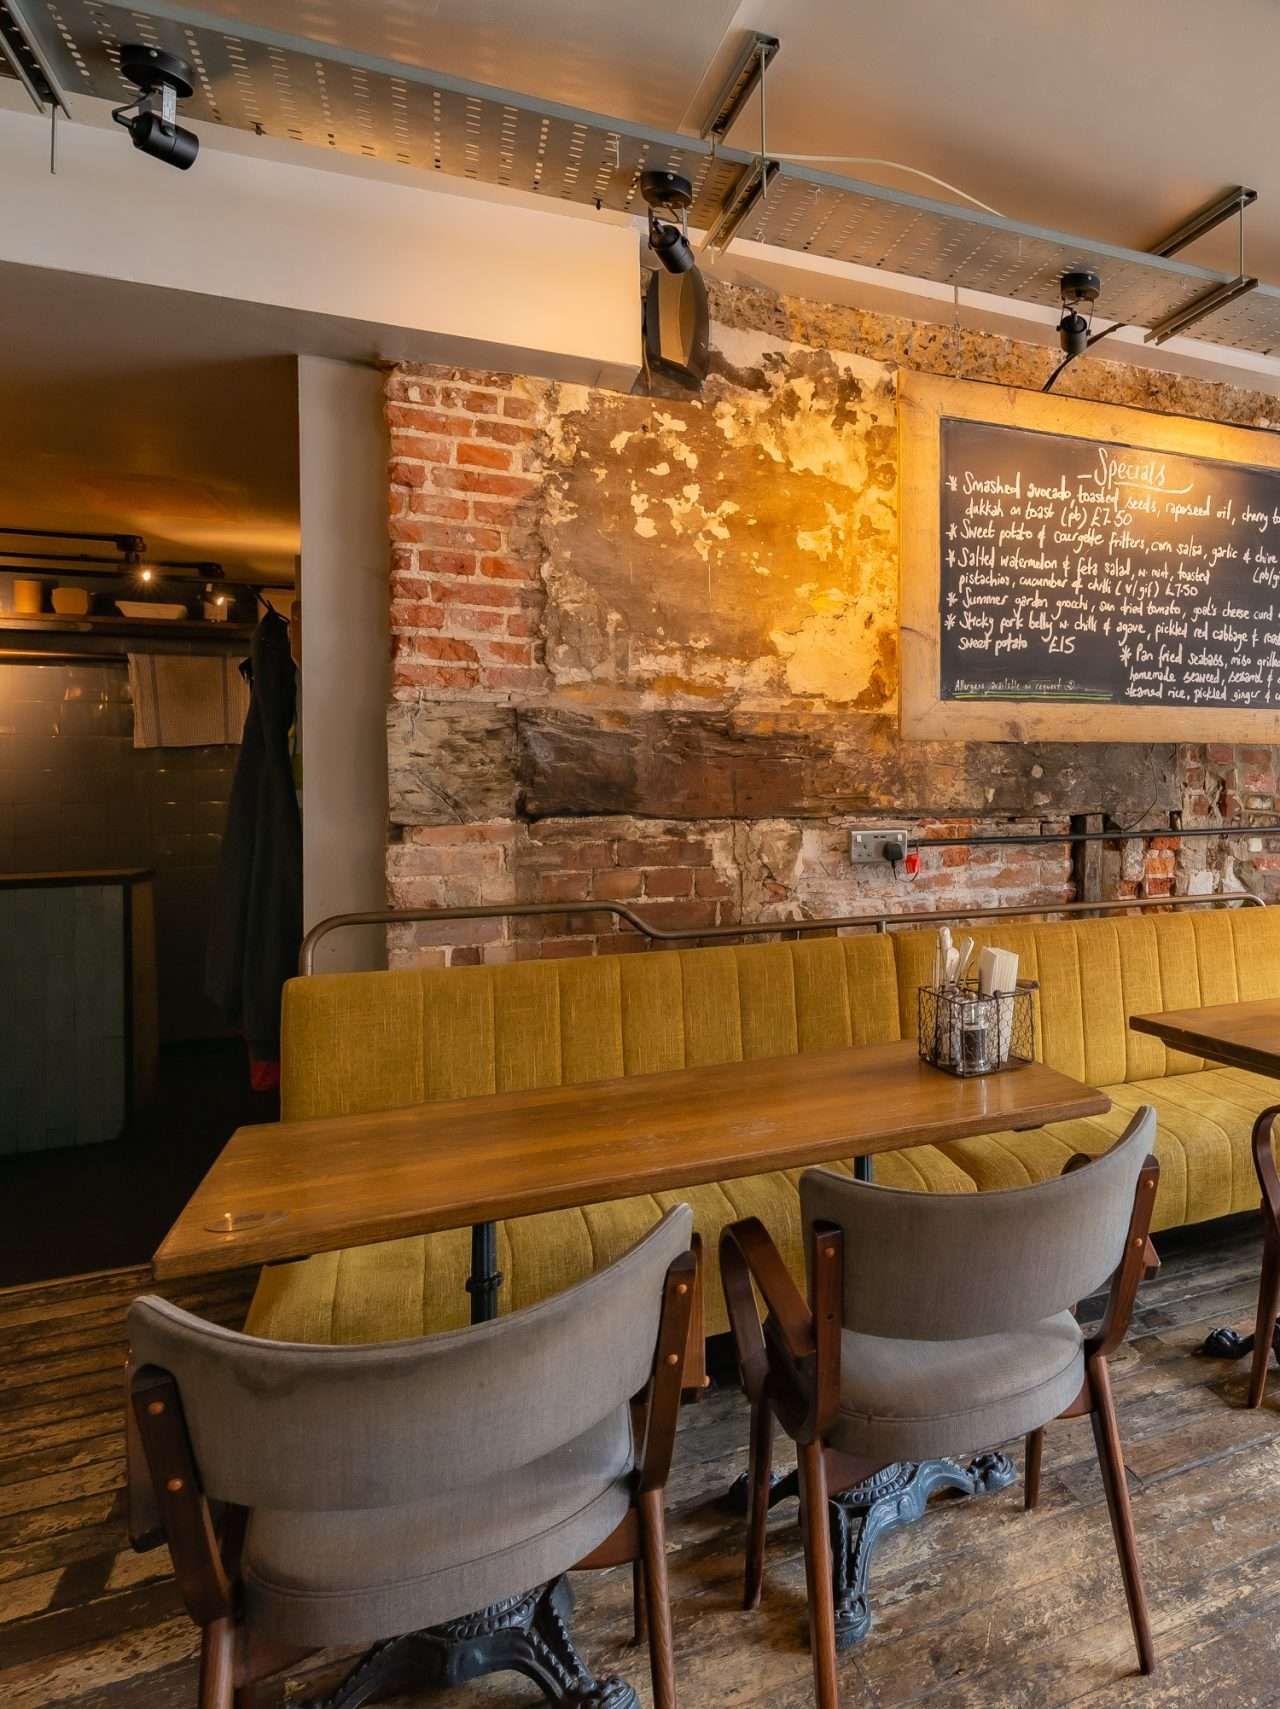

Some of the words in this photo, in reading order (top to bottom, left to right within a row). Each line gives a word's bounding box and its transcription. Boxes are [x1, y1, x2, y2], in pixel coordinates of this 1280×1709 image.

[1094, 448, 1166, 488] Specials
[963, 472, 1021, 499] Smashed
[1027, 475, 1075, 508] avocado,
[1078, 484, 1119, 512] toasted
[1125, 496, 1160, 519] seeds,
[1216, 499, 1236, 525] oil,
[1242, 504, 1268, 533] cherry
[965, 497, 1004, 518] dukkah
[1010, 506, 1021, 516] on
[1025, 501, 1055, 519] toast
[1061, 505, 1087, 530] (pb)
[960, 518, 996, 539] Sweet
[999, 521, 1033, 547] potato
[1037, 524, 1046, 549] &
[1054, 528, 1104, 554] courgette
[1109, 531, 1149, 555] fritters,
[1151, 541, 1172, 553] corn
[1176, 535, 1208, 559] salsa,
[1209, 544, 1238, 567] garlic
[1242, 548, 1252, 564] &
[1255, 546, 1278, 564] chive
[958, 545, 995, 568] Salted
[1000, 547, 1057, 570] watermelon
[1062, 555, 1071, 578] &
[1077, 557, 1098, 579] feta
[1105, 557, 1135, 581] salad,
[1151, 561, 1174, 581] mint,
[1177, 561, 1211, 585] toasted
[959, 569, 1015, 594] pistachios,
[1019, 572, 1068, 588] cucumber
[1071, 577, 1083, 595] &
[1088, 577, 1111, 594] chilli
[1165, 582, 1199, 598] £7.50
[962, 587, 1008, 608] Summer
[1015, 589, 1048, 618] garden
[1051, 594, 1095, 620] gnocchi,
[1099, 600, 1115, 612] sun
[1120, 596, 1143, 616] dried
[1147, 598, 1186, 619] tomato,
[1191, 596, 1216, 622] goat's
[1222, 600, 1250, 619] cheese
[1253, 604, 1273, 621] curd
[958, 632, 992, 650] sweet
[995, 632, 1028, 656] potato
[1049, 635, 1076, 654] £15
[959, 611, 994, 635] Sticky
[1000, 611, 1024, 634] pork
[1029, 610, 1053, 642] belly
[1075, 613, 1098, 632] chilli
[1103, 617, 1111, 636] &
[1116, 622, 1151, 646] agave,
[1155, 620, 1188, 642] pickled
[1194, 621, 1208, 640] red
[1212, 624, 1248, 653] cabbage
[1136, 642, 1153, 661] Pan
[1158, 641, 1182, 668] fried
[1231, 654, 1252, 667] miso
[1130, 665, 1176, 682] homemade
[1184, 668, 1224, 686] seaweed,
[1125, 683, 1162, 698] steamed
[1168, 687, 1189, 700] rice,
[1194, 686, 1226, 703] pickled
[1232, 688, 1260, 704] ginger
